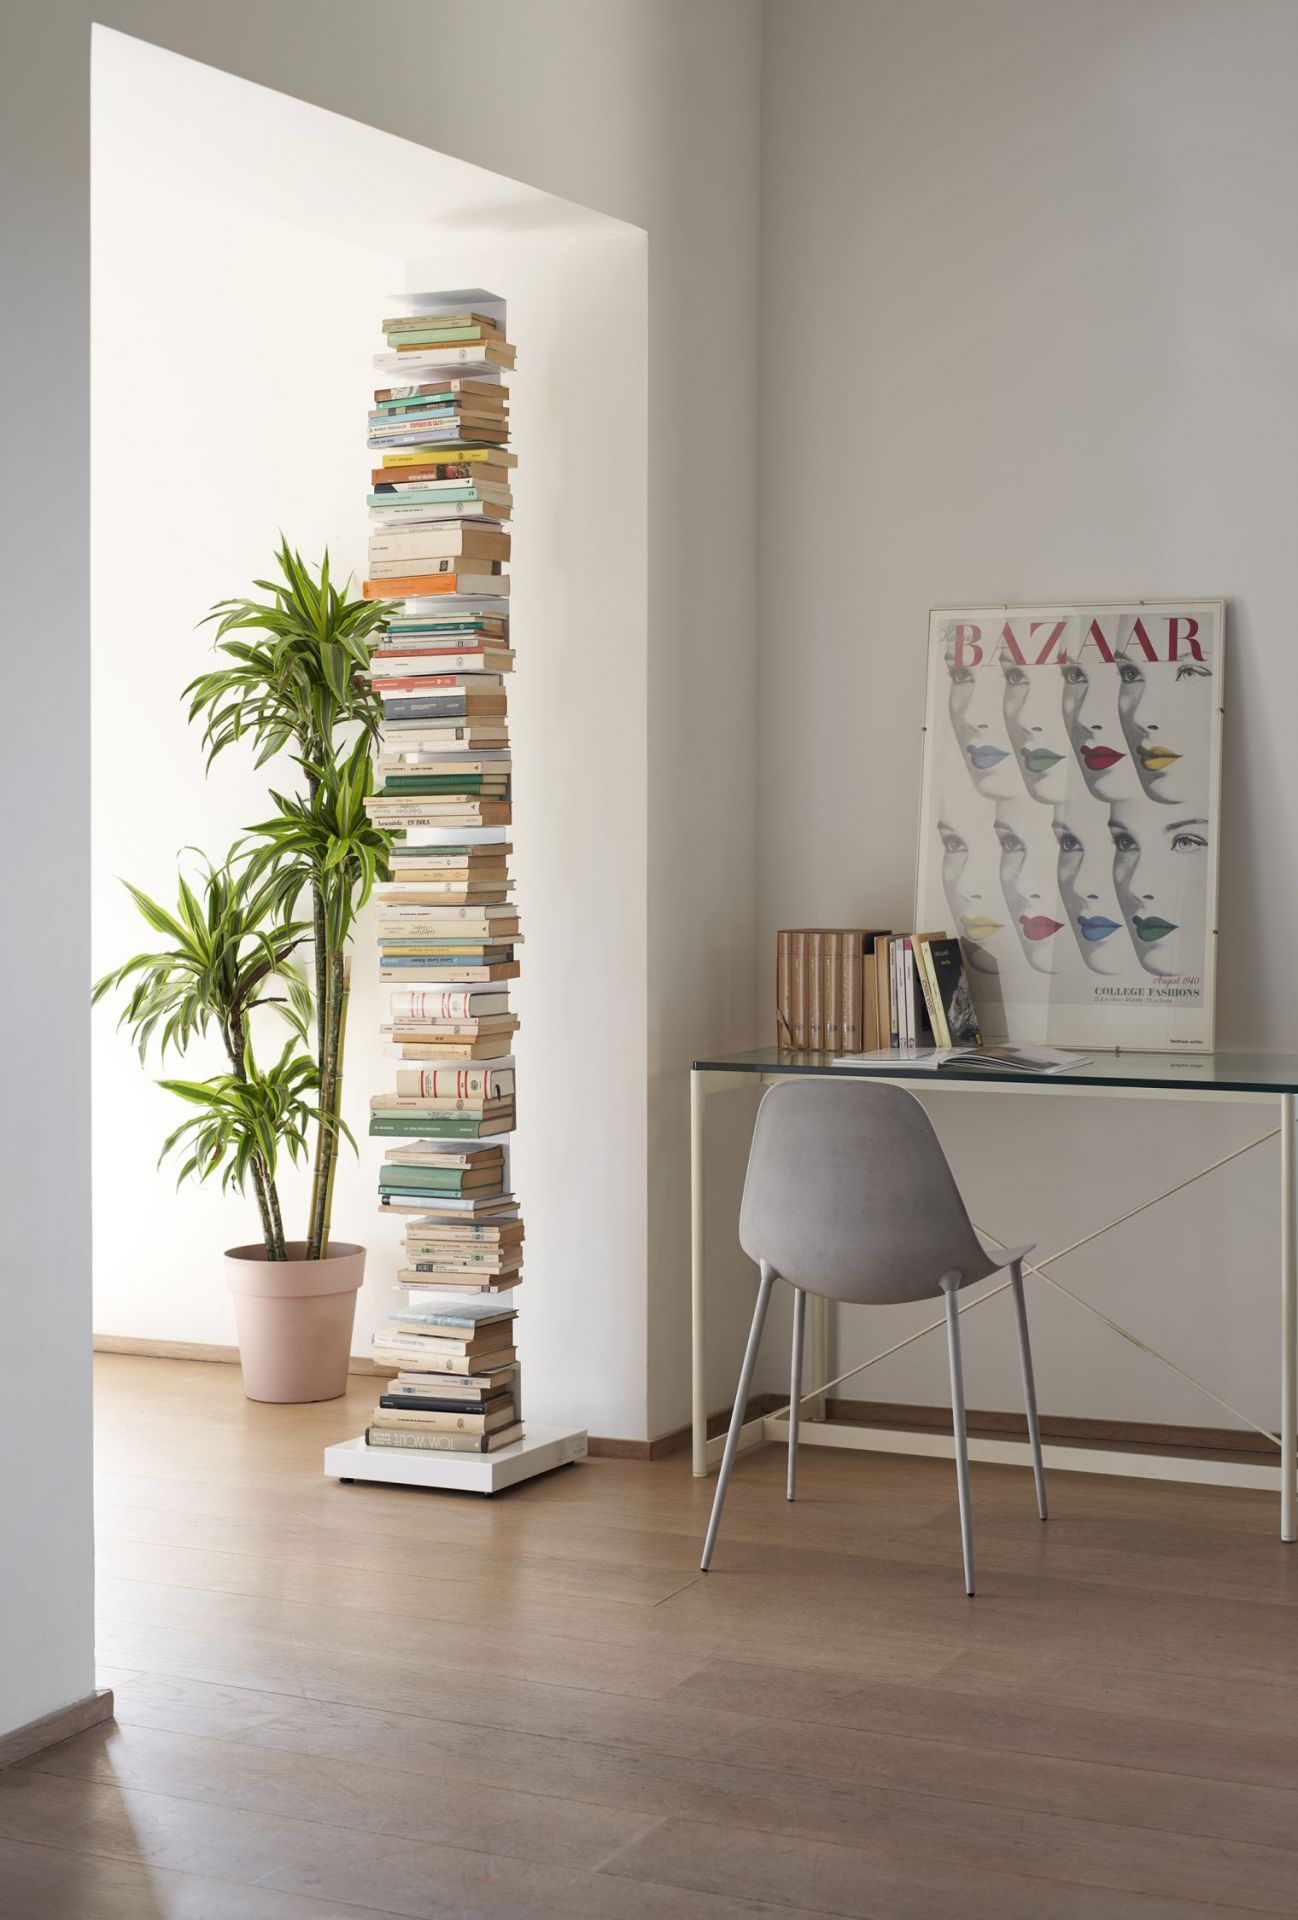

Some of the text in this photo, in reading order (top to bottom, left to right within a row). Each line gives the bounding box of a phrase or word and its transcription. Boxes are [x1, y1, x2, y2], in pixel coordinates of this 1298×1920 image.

[953, 616, 1208, 667] BAZAAR
[1152, 976, 1200, 987] August 1940
[1094, 986, 1200, 997] COLLEGE FASHIONS
[428, 1436, 455, 1450] TOM
